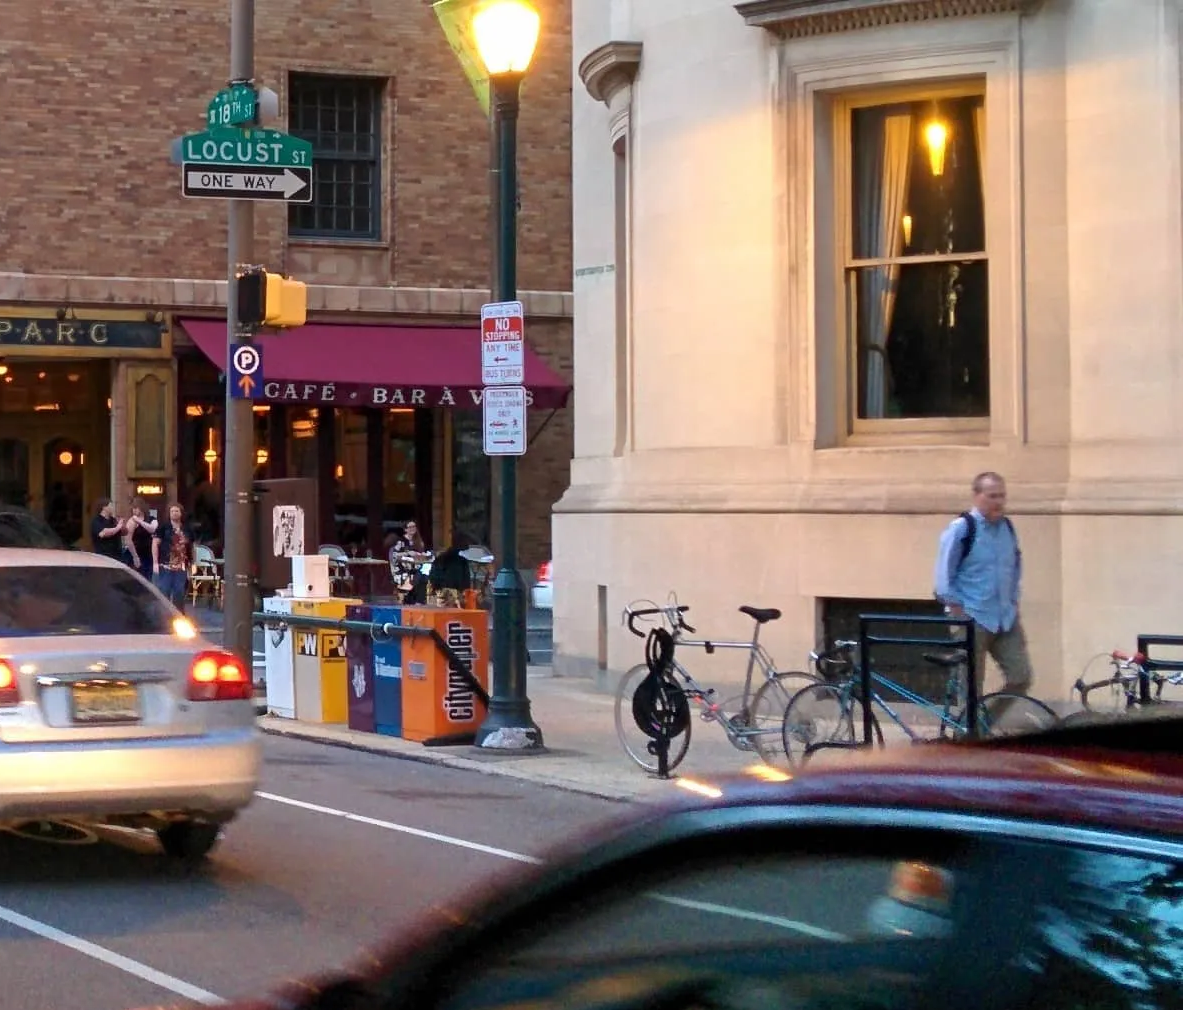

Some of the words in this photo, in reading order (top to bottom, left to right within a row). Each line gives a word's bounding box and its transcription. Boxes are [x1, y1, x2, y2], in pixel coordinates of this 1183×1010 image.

[218, 101, 241, 124] 18TH
[244, 104, 252, 118] ST
[187, 139, 283, 163] LOCUST
[292, 150, 306, 164] ST
[201, 174, 233, 188] ONE
[243, 176, 276, 189] WAY
[494, 317, 510, 331] NO
[484, 330, 520, 342] STOPPING
[486, 343, 502, 353] ANY
[504, 342, 520, 353] TIME
[264, 382, 335, 401] CAFÉ
[373, 387, 426, 405] BAR
[439, 386, 457, 405] À
[469, 389, 534, 406] VS
[297, 632, 317, 656] PW
